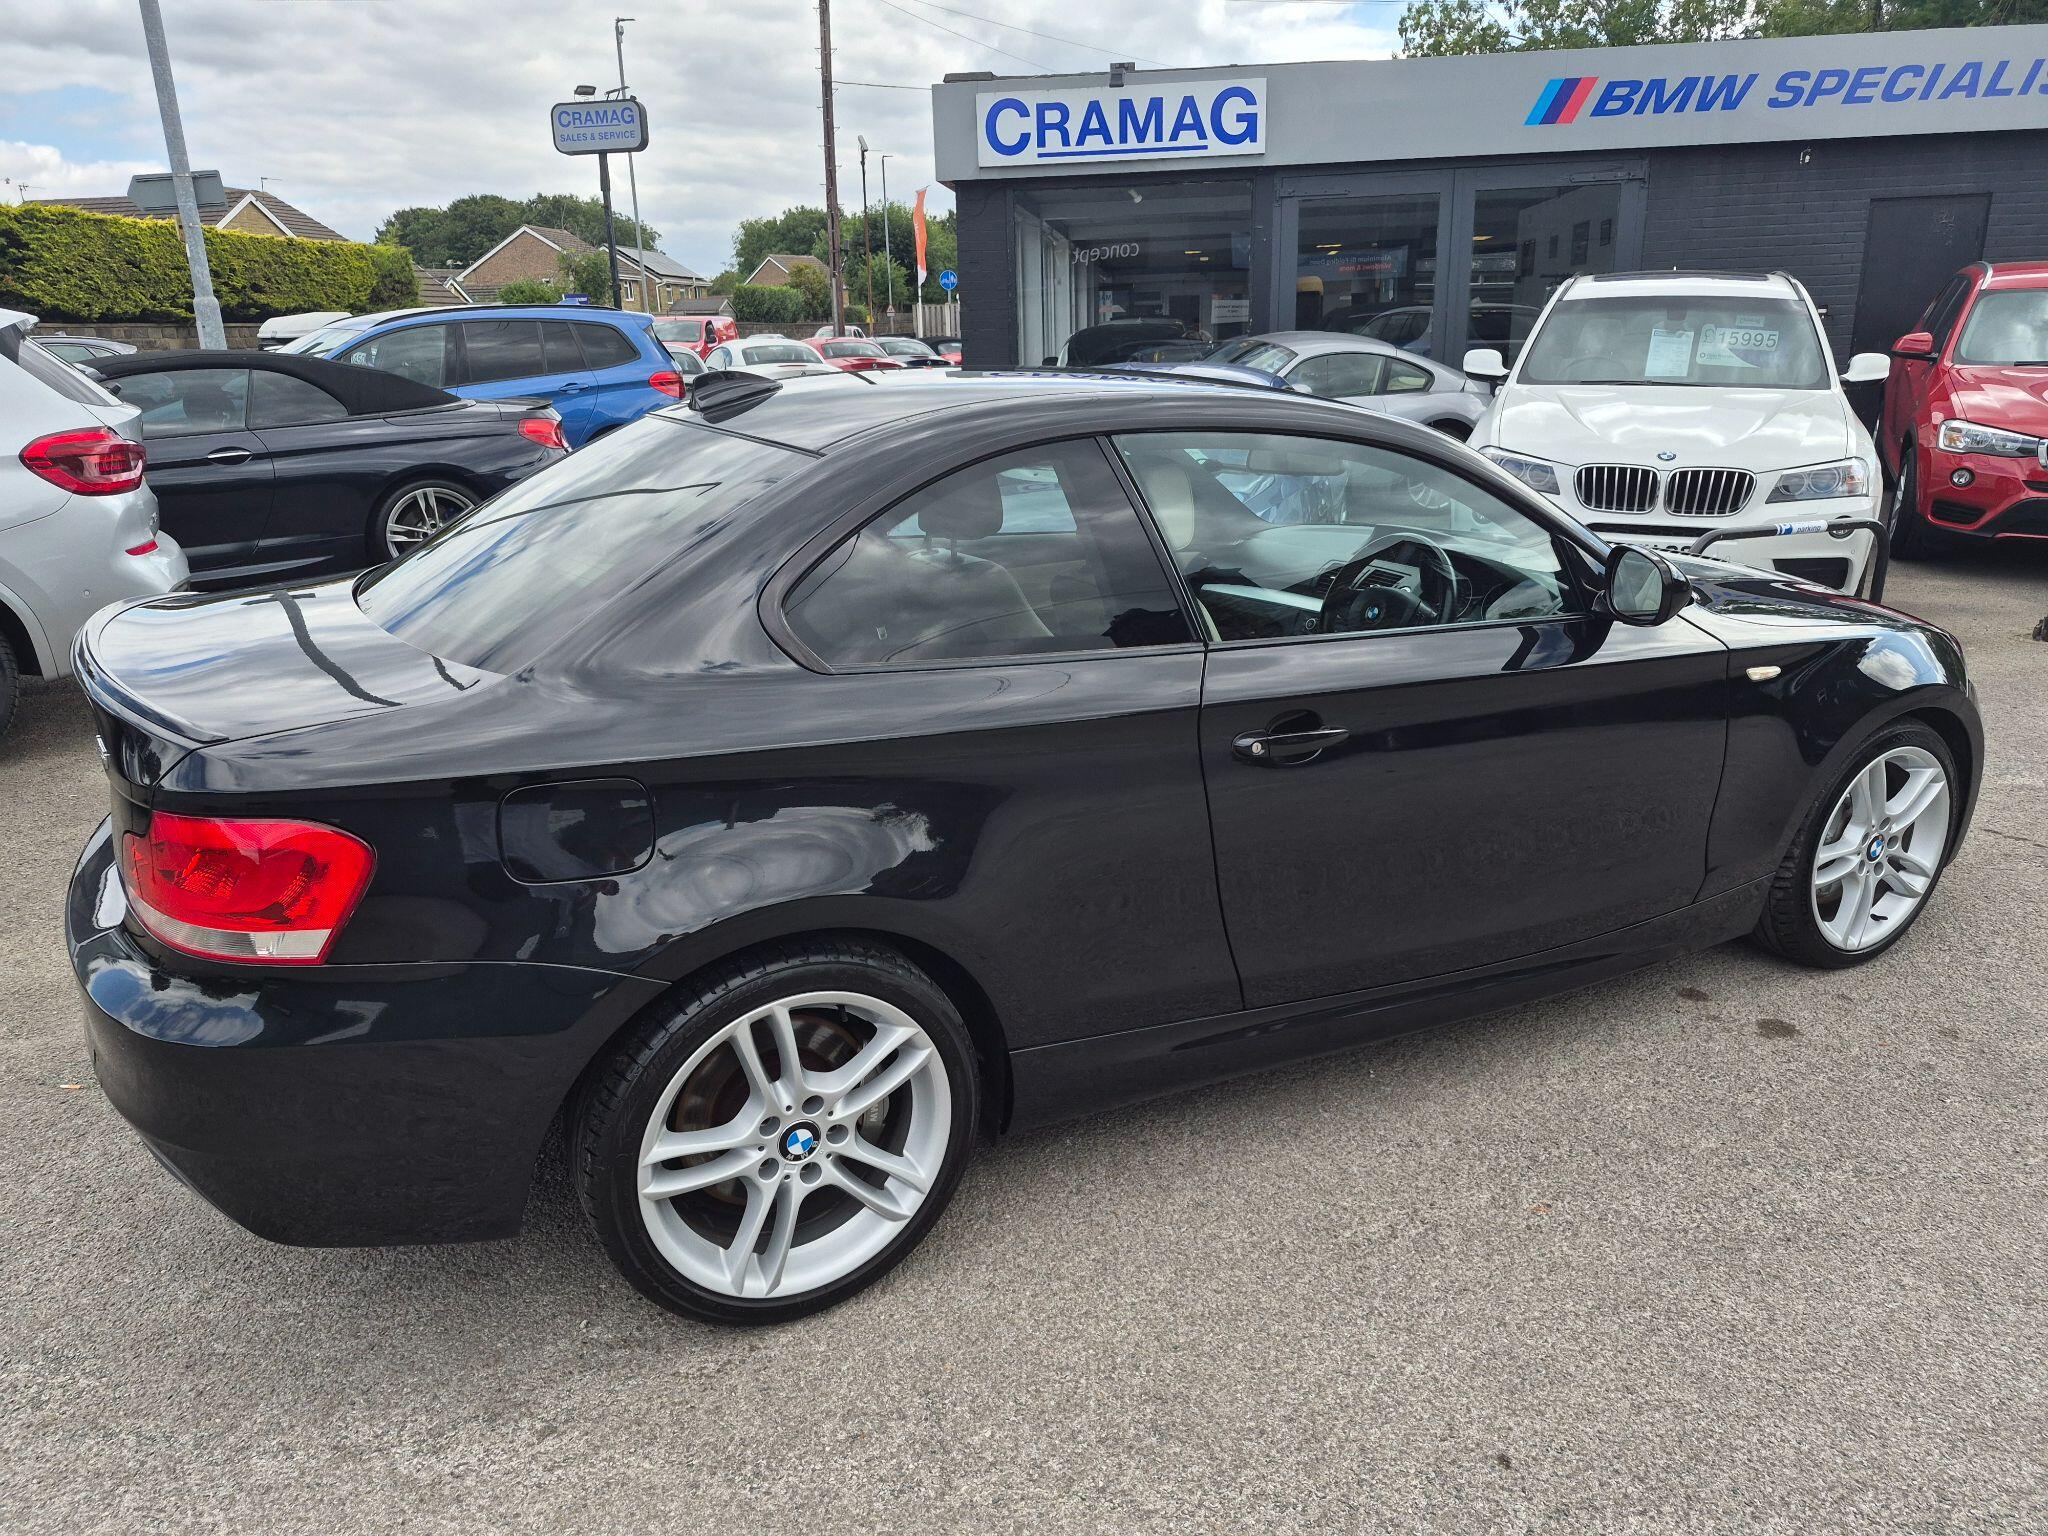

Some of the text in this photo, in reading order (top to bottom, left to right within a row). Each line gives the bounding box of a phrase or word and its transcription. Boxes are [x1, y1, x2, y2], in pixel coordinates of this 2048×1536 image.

[1590, 58, 2048, 117] BMW SPECIALI
[558, 107, 635, 128] CRAMAG
[560, 130, 636, 142] SALES & SERVICE
[985, 86, 1258, 156] CRAMAG
